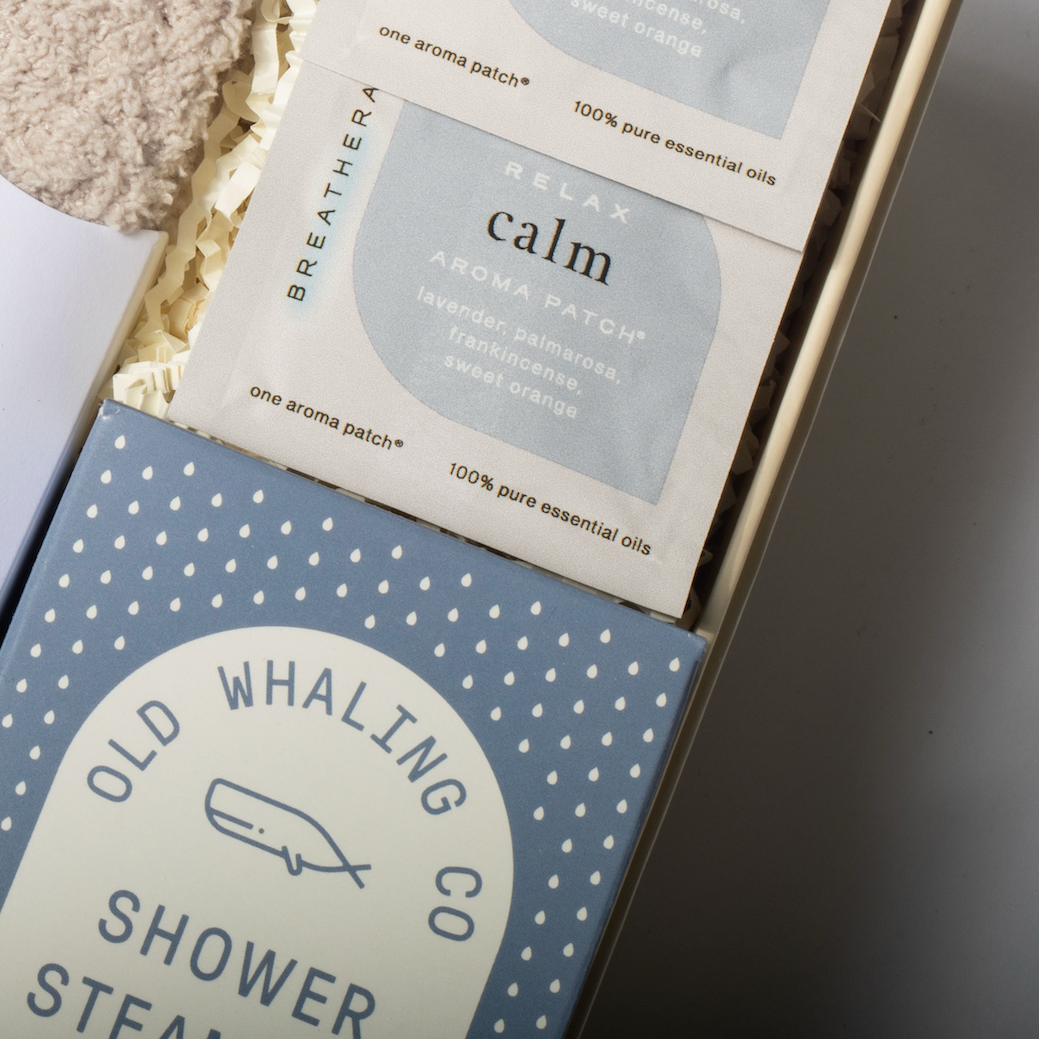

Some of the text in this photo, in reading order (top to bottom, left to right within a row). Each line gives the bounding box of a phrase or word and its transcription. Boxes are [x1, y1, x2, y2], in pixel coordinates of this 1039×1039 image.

[379, 27, 411, 44] one
[414, 40, 467, 68] aroma
[634, 22, 702, 58] orange
[575, 101, 776, 186] 100% pure essential oils
[504, 161, 630, 224] RELAX
[429, 250, 529, 301] AROMA
[487, 211, 611, 286] calm
[417, 285, 621, 385] lavender, palmarosa,
[449, 326, 582, 395] frankincense,
[250, 386, 282, 406] one
[286, 400, 339, 430] aroma
[444, 355, 577, 419] sweet orange
[450, 463, 651, 555] 100% pure essential oils
[86, 660, 483, 942] OLD WHALING CO
[98, 889, 376, 1039] SHOWER
